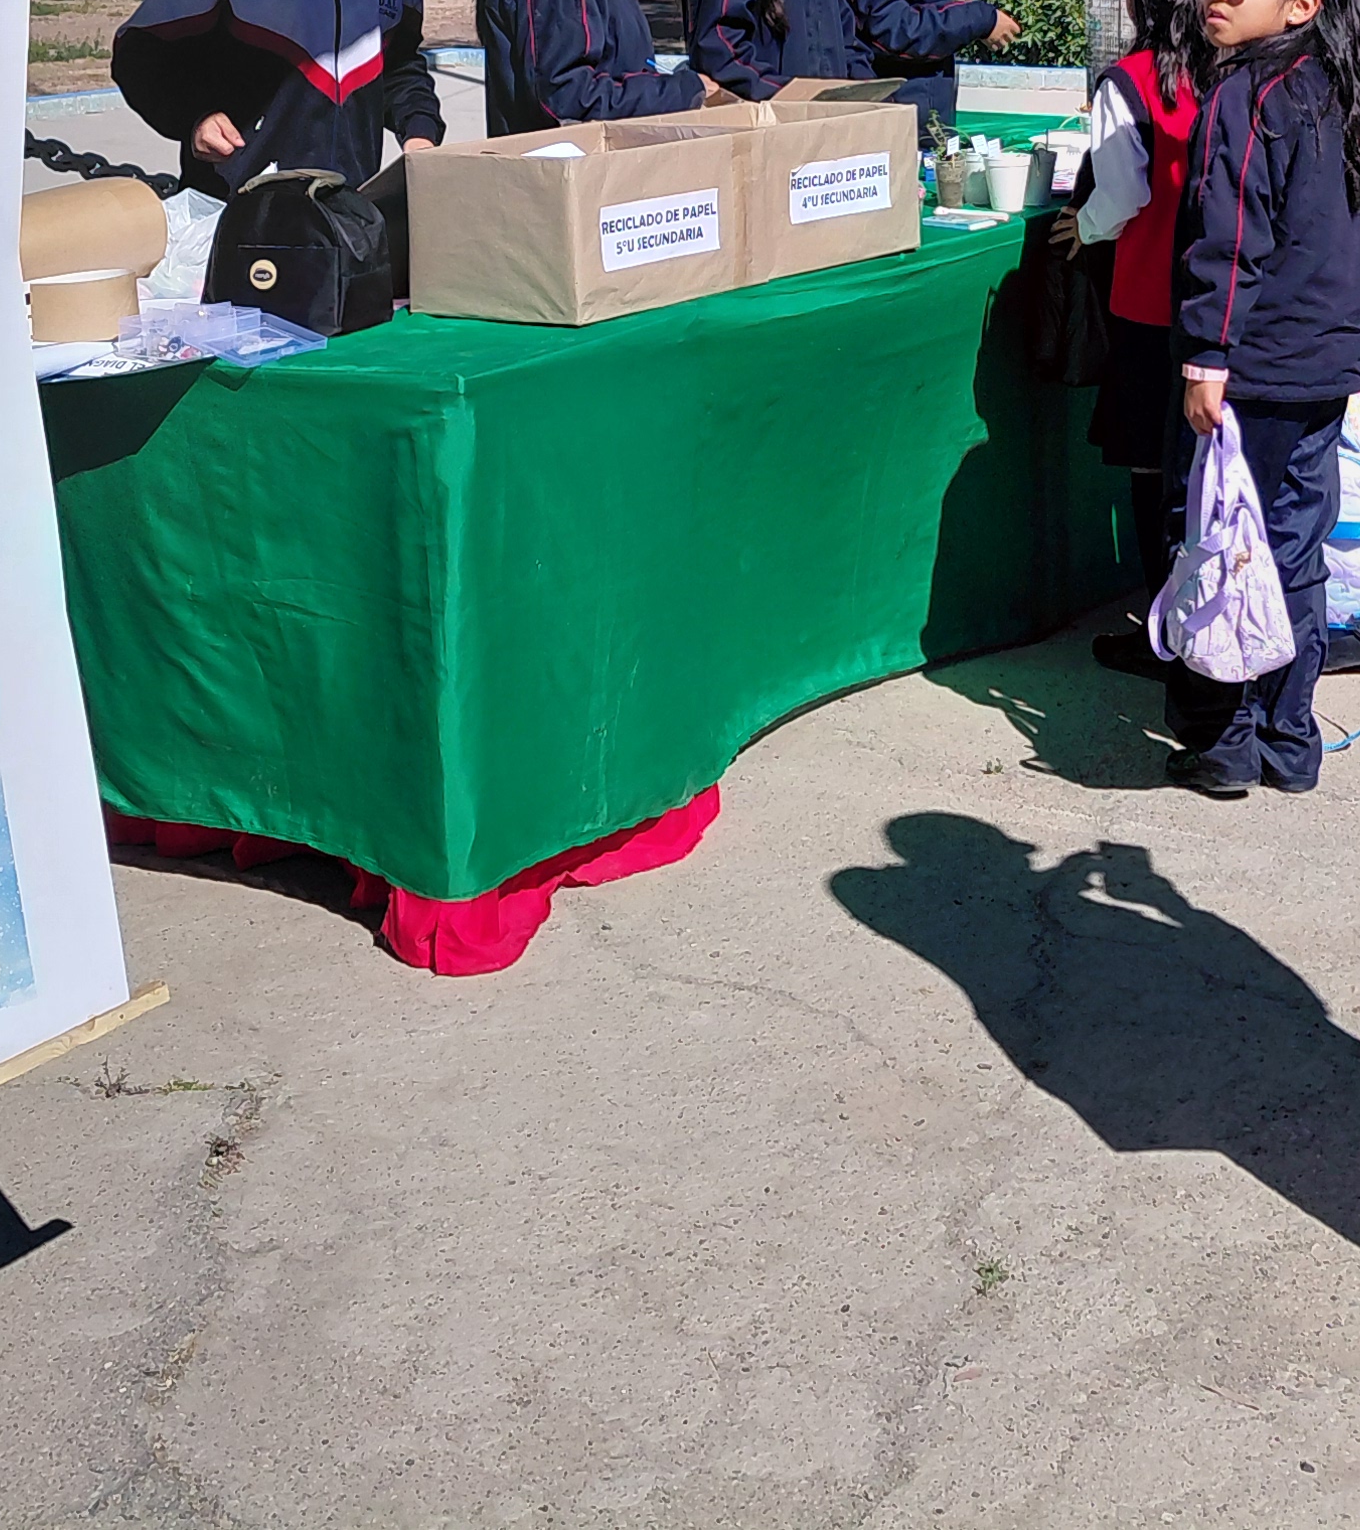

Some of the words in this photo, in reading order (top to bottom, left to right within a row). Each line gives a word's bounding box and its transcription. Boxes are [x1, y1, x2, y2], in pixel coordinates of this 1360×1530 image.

[790, 171, 844, 191] RECICLADO
[846, 168, 857, 182] DE
[859, 164, 888, 181] PAPEL
[820, 185, 879, 208] SECUNDARIA
[601, 212, 663, 235] RECICLADO
[666, 208, 680, 222] DE
[683, 202, 717, 219] PAPEL
[637, 226, 704, 251] SECUNDARIA
